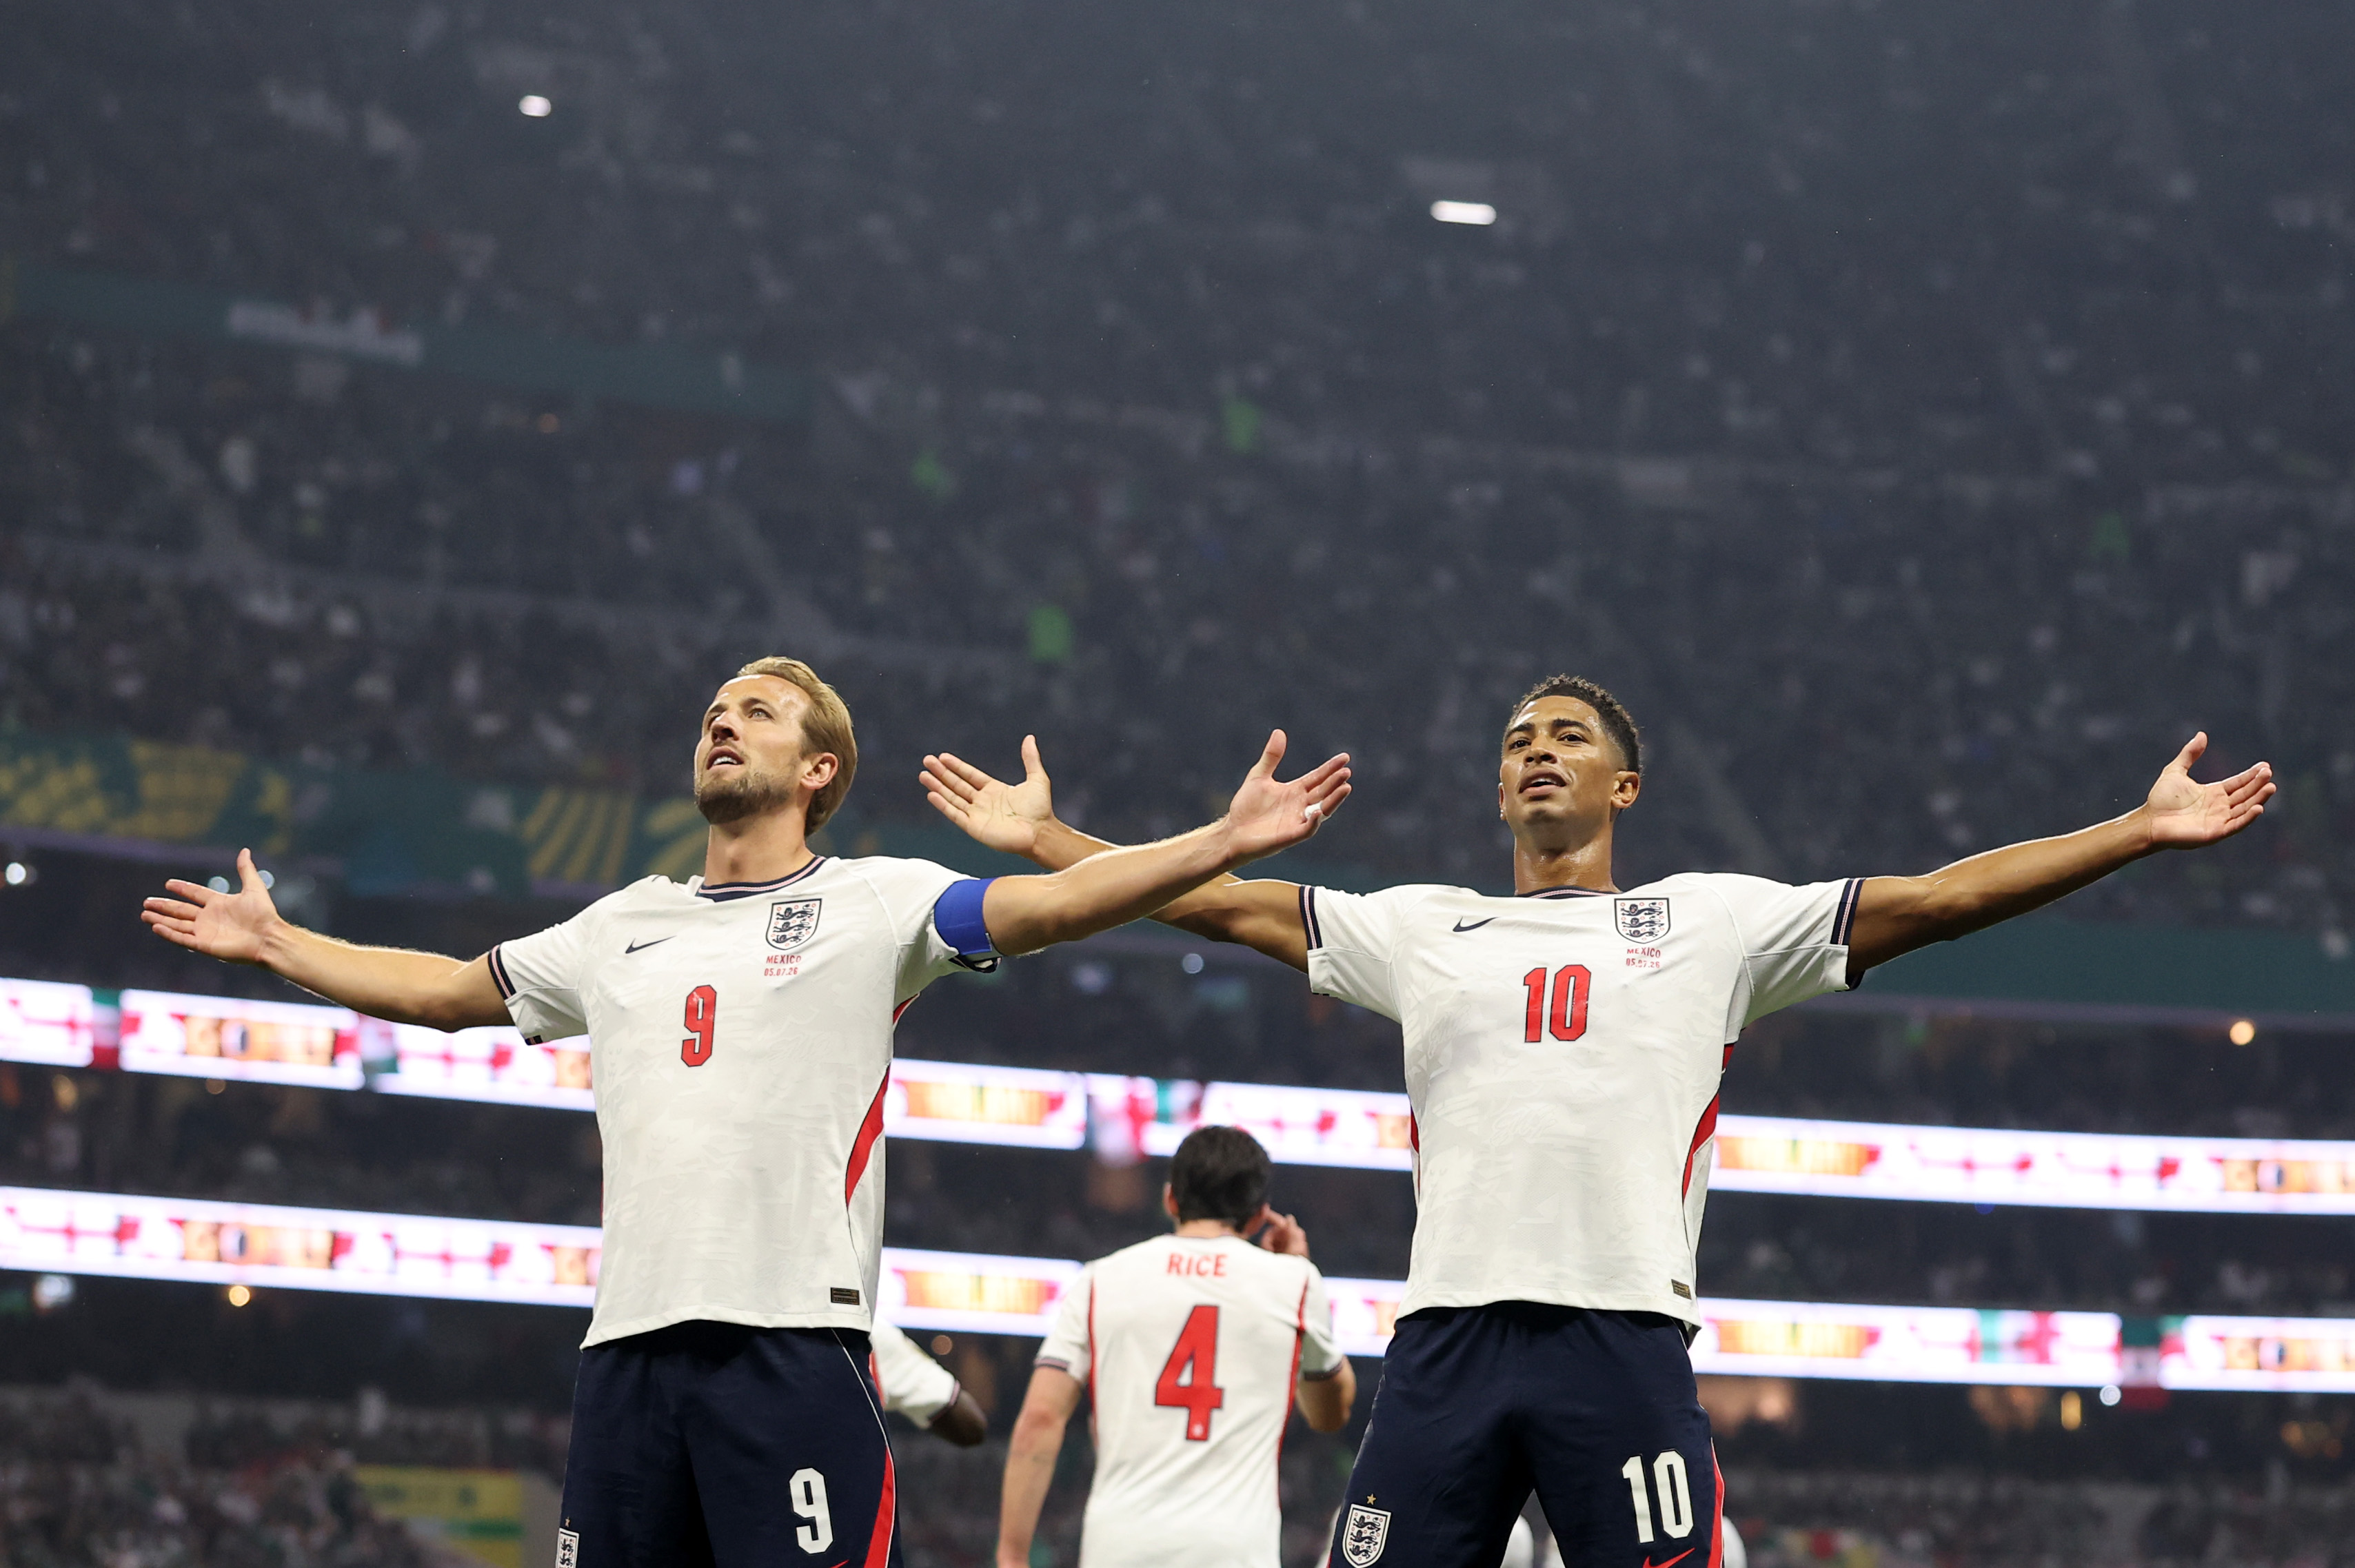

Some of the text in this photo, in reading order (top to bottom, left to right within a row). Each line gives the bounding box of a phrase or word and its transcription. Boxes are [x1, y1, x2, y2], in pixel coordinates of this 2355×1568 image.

[764, 967, 798, 977] 05.07.26
[766, 955, 802, 964] MEXICO
[1626, 947, 1661, 958] MEXICO
[680, 984, 717, 1068] 9
[1523, 964, 1592, 1043] 10
[1166, 1252, 1229, 1277] RICE
[1155, 1304, 1224, 1441] 4
[789, 1467, 833, 1554] 9
[1621, 1449, 1695, 1544] 10
